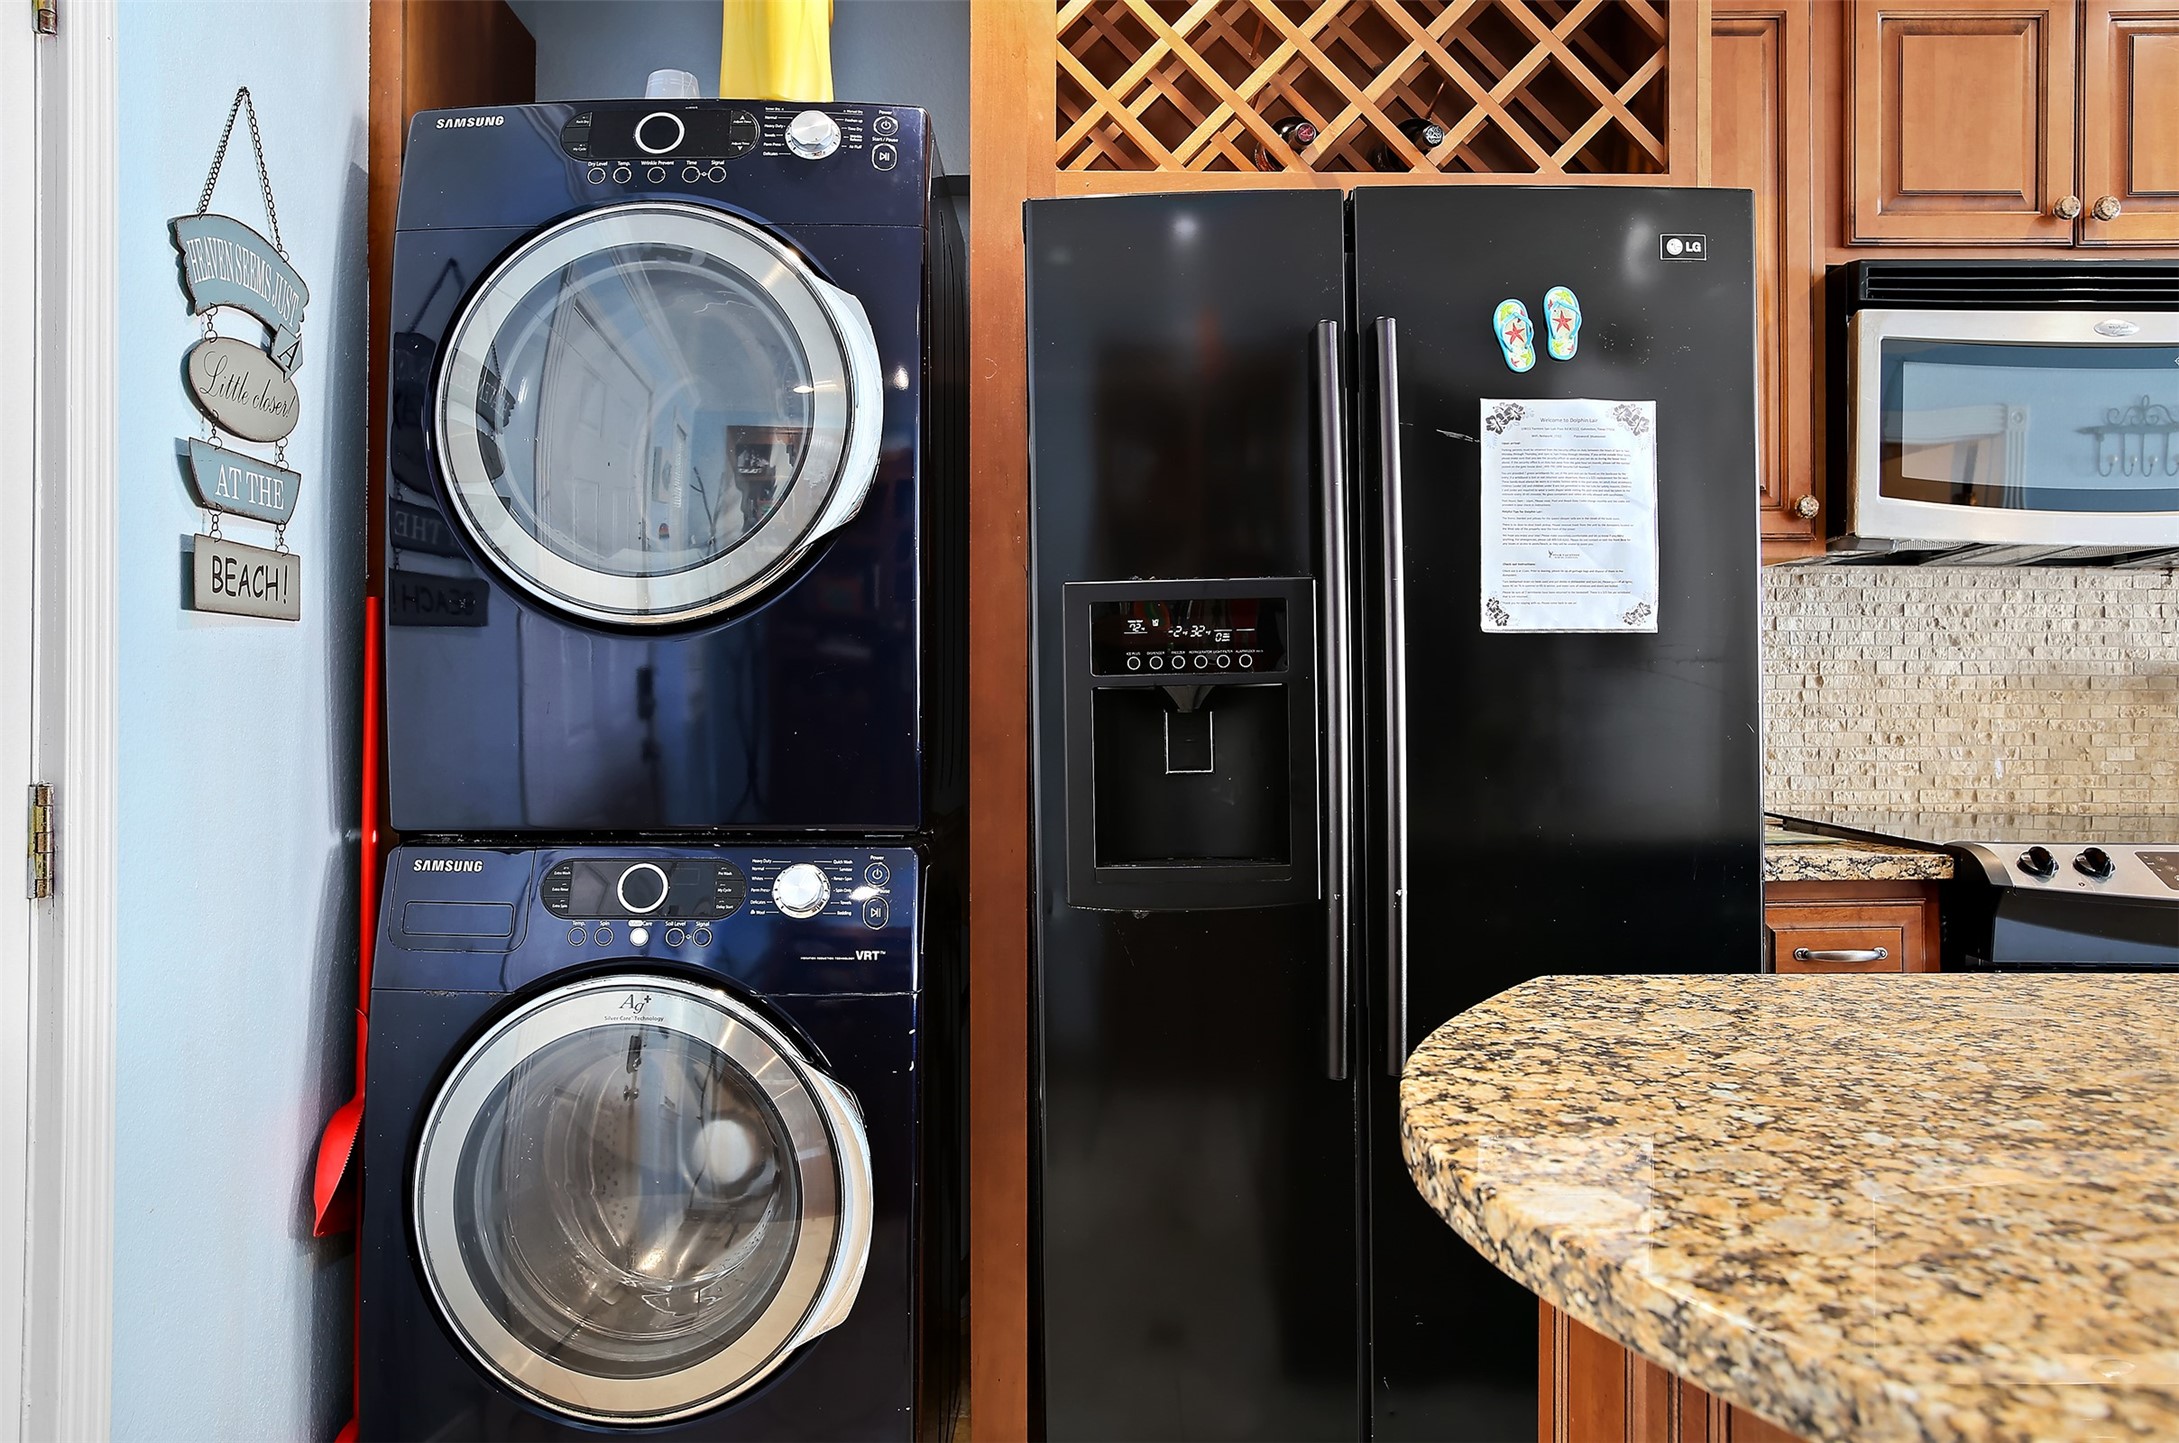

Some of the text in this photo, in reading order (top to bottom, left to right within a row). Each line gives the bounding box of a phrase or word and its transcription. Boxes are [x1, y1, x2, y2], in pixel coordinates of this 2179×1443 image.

[436, 115, 505, 129] SAMSUNG
[1685, 241, 1702, 253] LG
[186, 236, 300, 327] HEAVEN SEEMS JUST
[277, 339, 300, 371] A
[199, 350, 297, 418] Little closer!
[215, 464, 284, 510] AT THE
[212, 555, 288, 604] BEACH!
[413, 859, 483, 872] SAMSUNG
